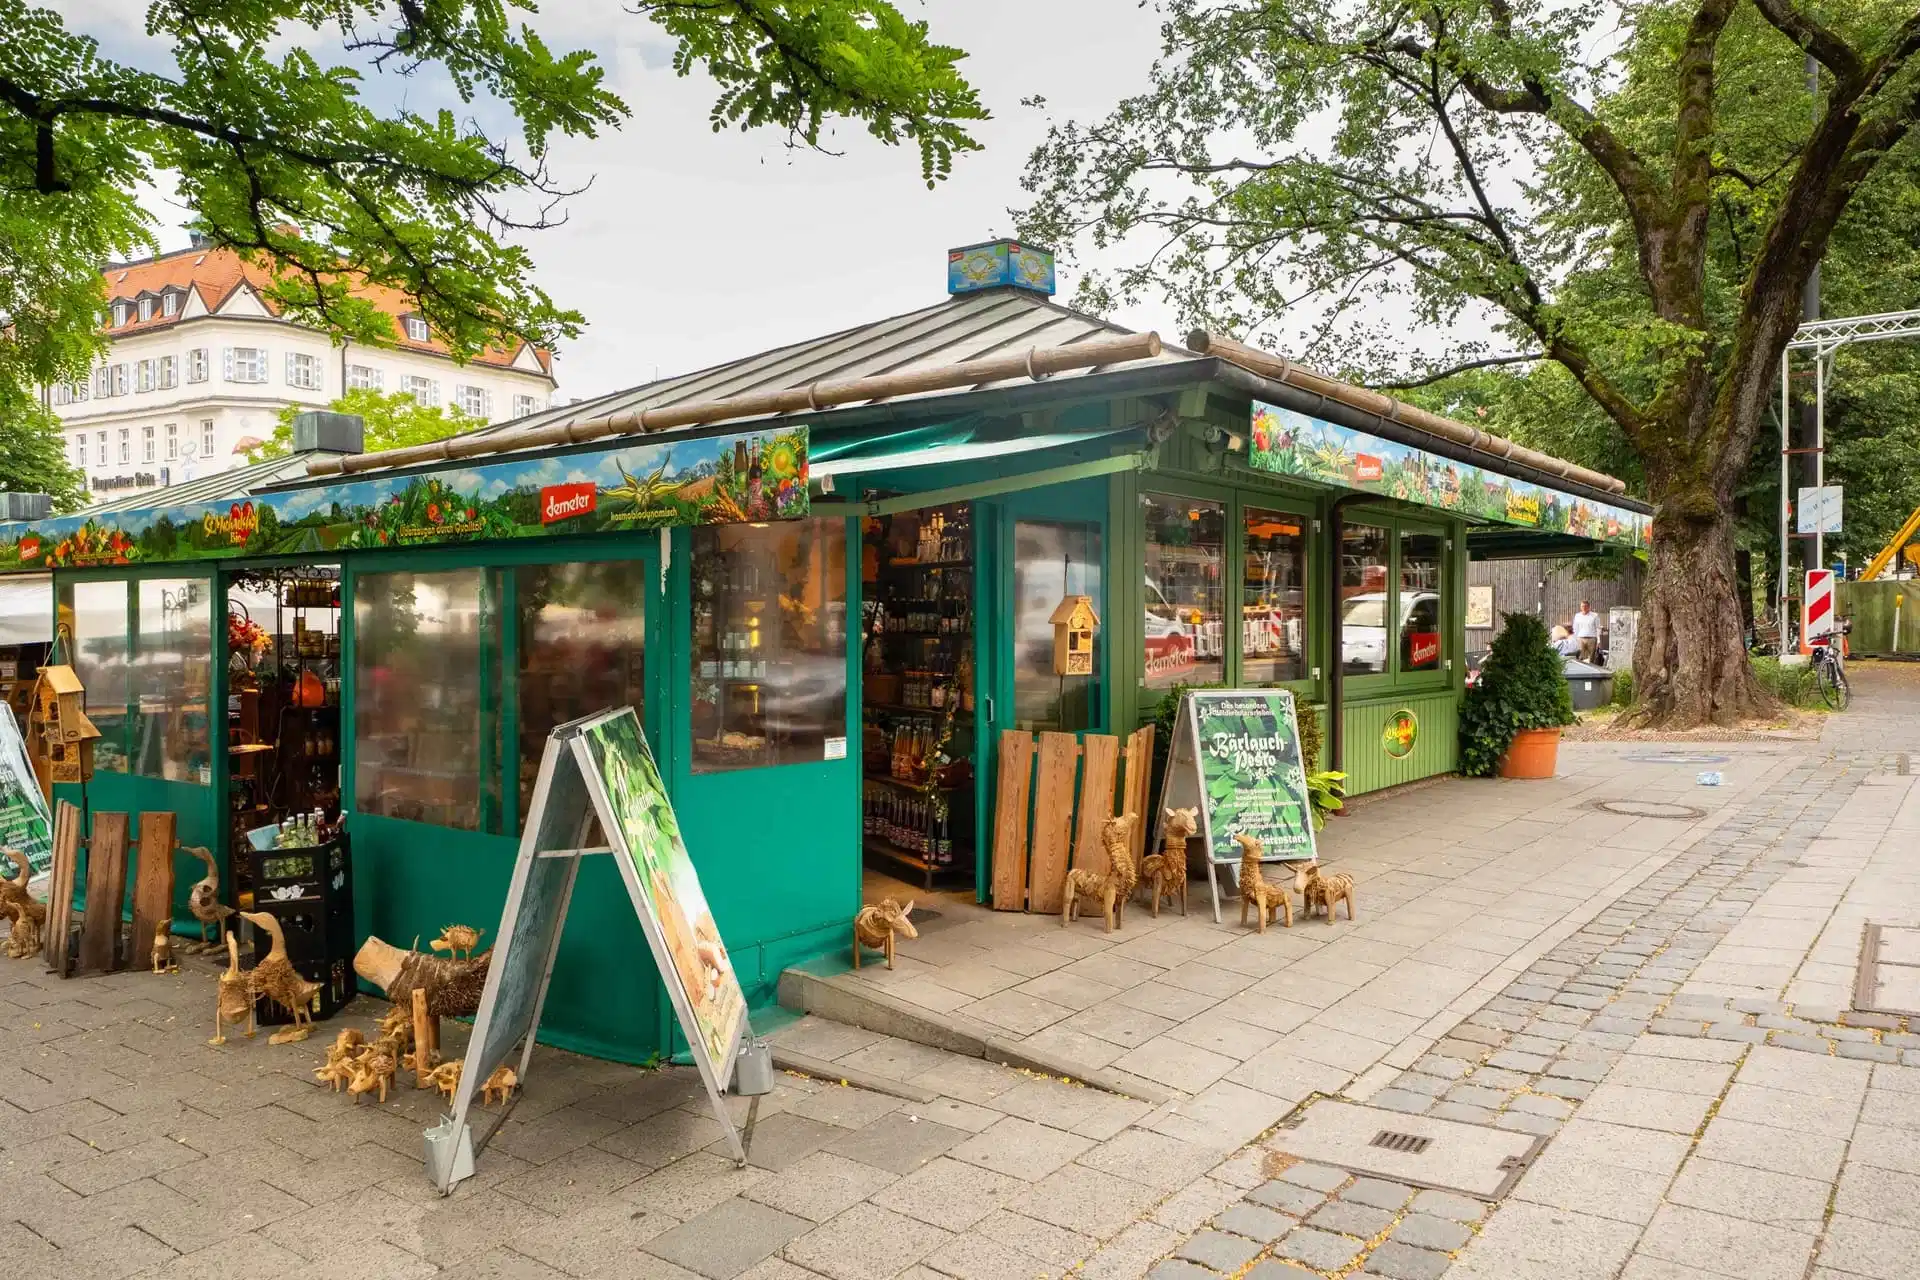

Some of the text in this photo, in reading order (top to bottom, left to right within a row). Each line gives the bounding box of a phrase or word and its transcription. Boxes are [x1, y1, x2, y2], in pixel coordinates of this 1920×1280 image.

[546, 493, 589, 518] demeter
[1145, 645, 1189, 675] demeter
[1414, 642, 1436, 662] demeter
[1209, 731, 1288, 758] Bärlauch-
